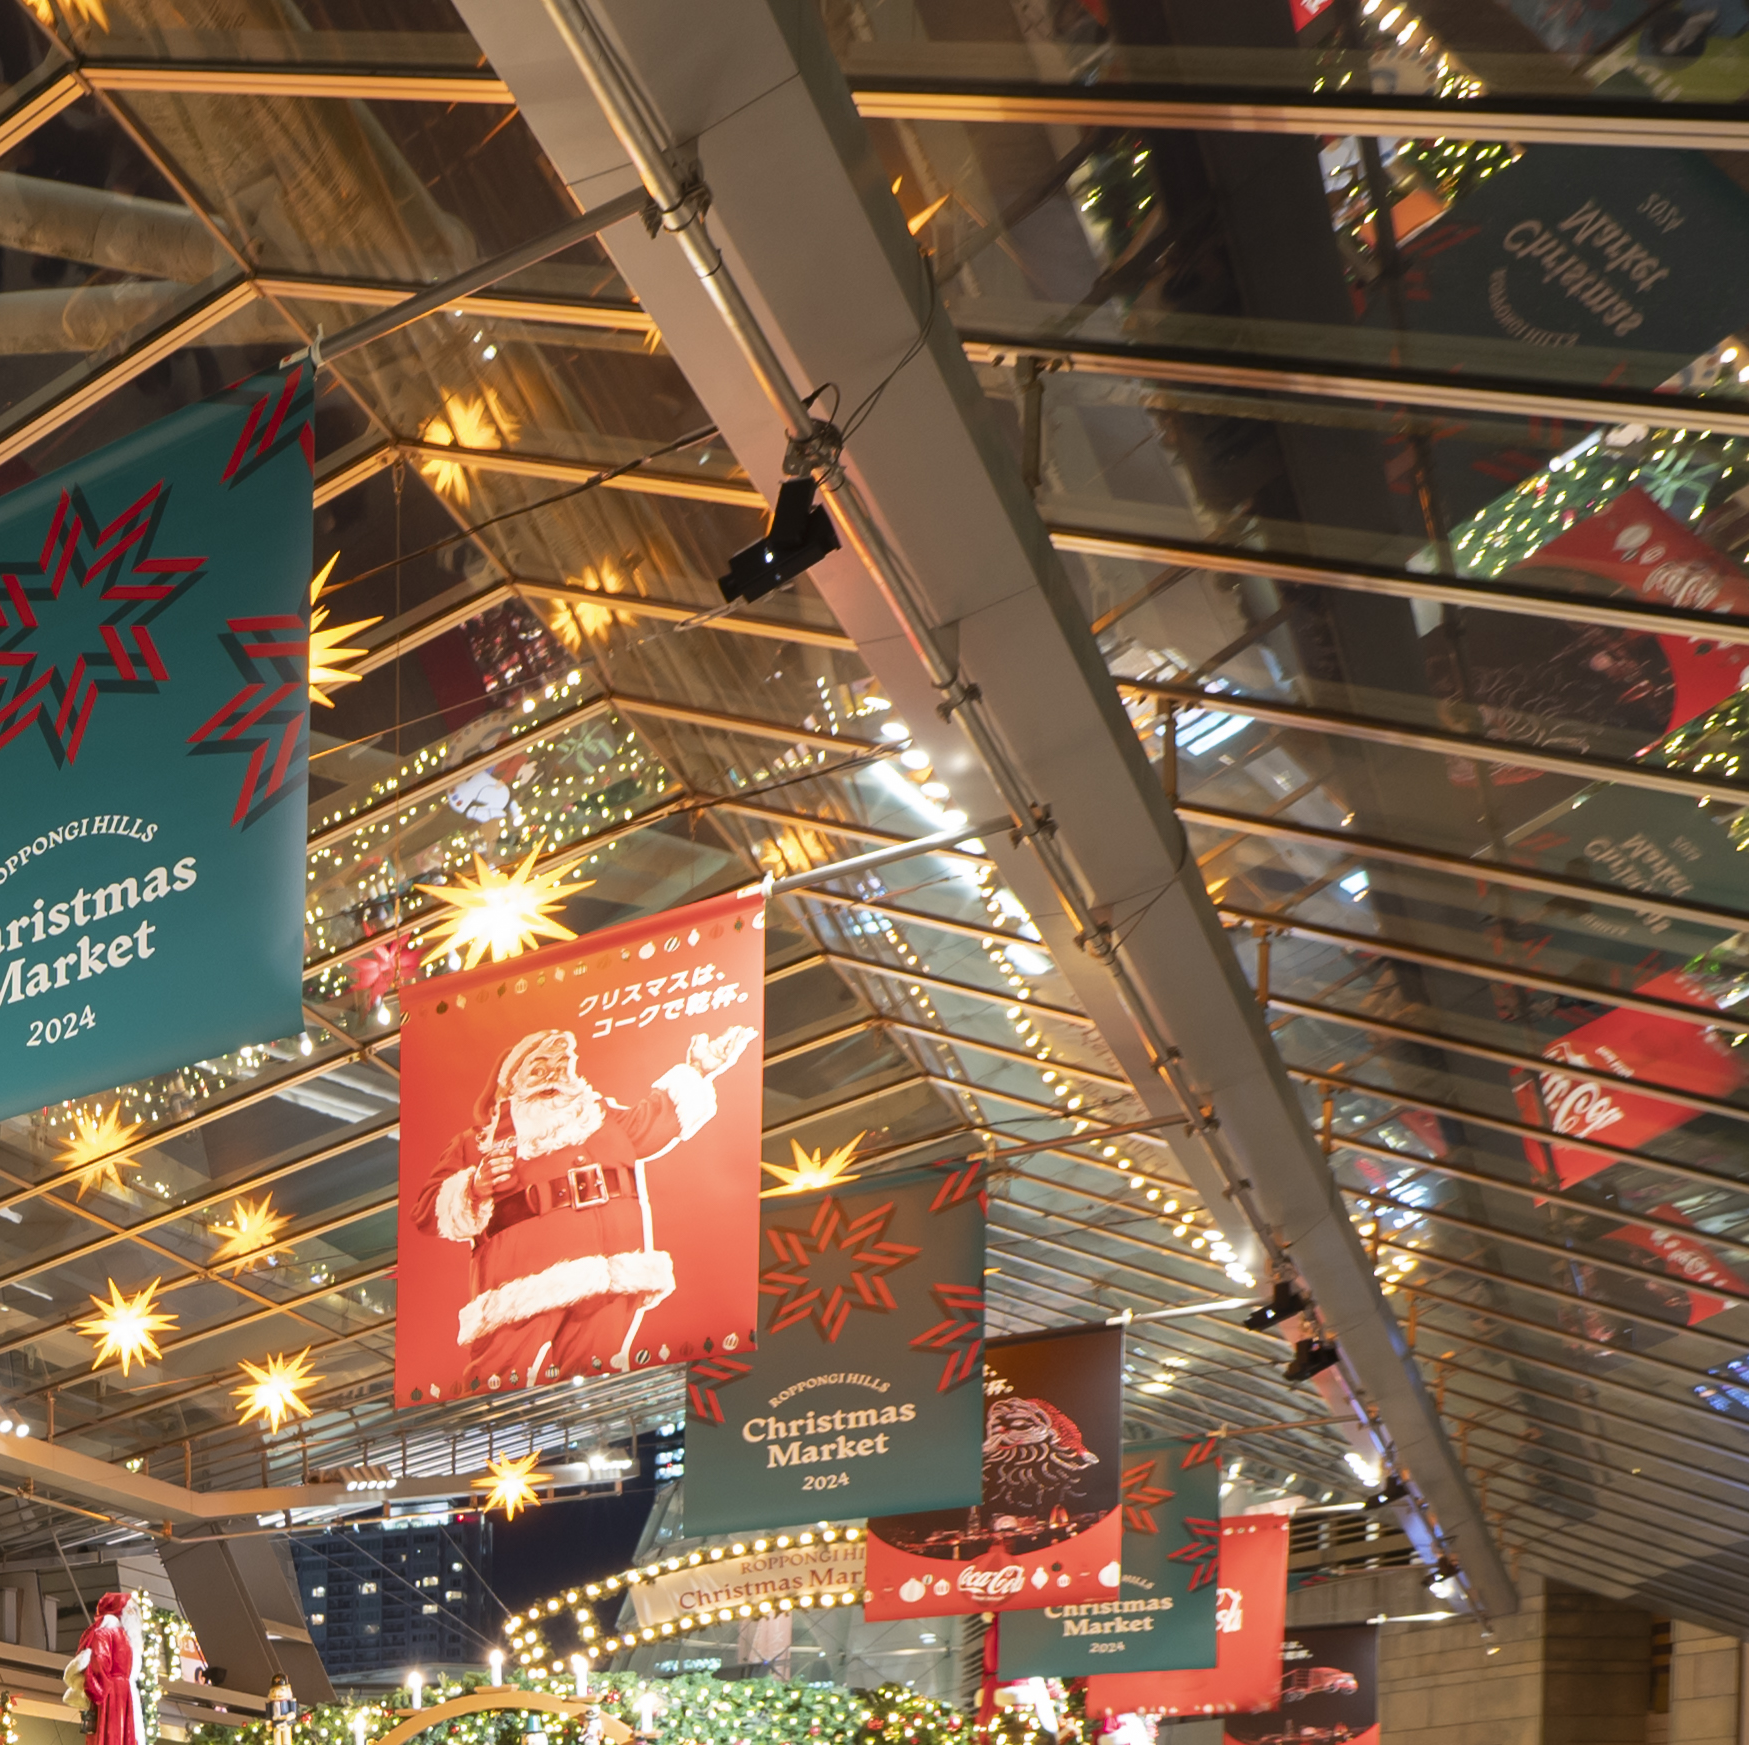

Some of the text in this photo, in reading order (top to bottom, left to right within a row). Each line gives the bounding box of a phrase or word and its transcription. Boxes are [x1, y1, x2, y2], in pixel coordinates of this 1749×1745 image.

[91, 815, 159, 843] HILLS
[578, 963, 726, 1018] クリスマスは、
[26, 1004, 96, 1047] 2024
[768, 1373, 891, 1408] ROPPONGI HILLS
[742, 1403, 917, 1443] Christmas
[766, 1432, 890, 1468] Market
[801, 1471, 850, 1490] 2024
[740, 1548, 840, 1575] ROPPONGI
[679, 1575, 804, 1611] Christmas
[957, 1564, 1026, 1595] Coca-Cola
[1062, 1616, 1155, 1638] Market
[1089, 1641, 1126, 1655] 2024
